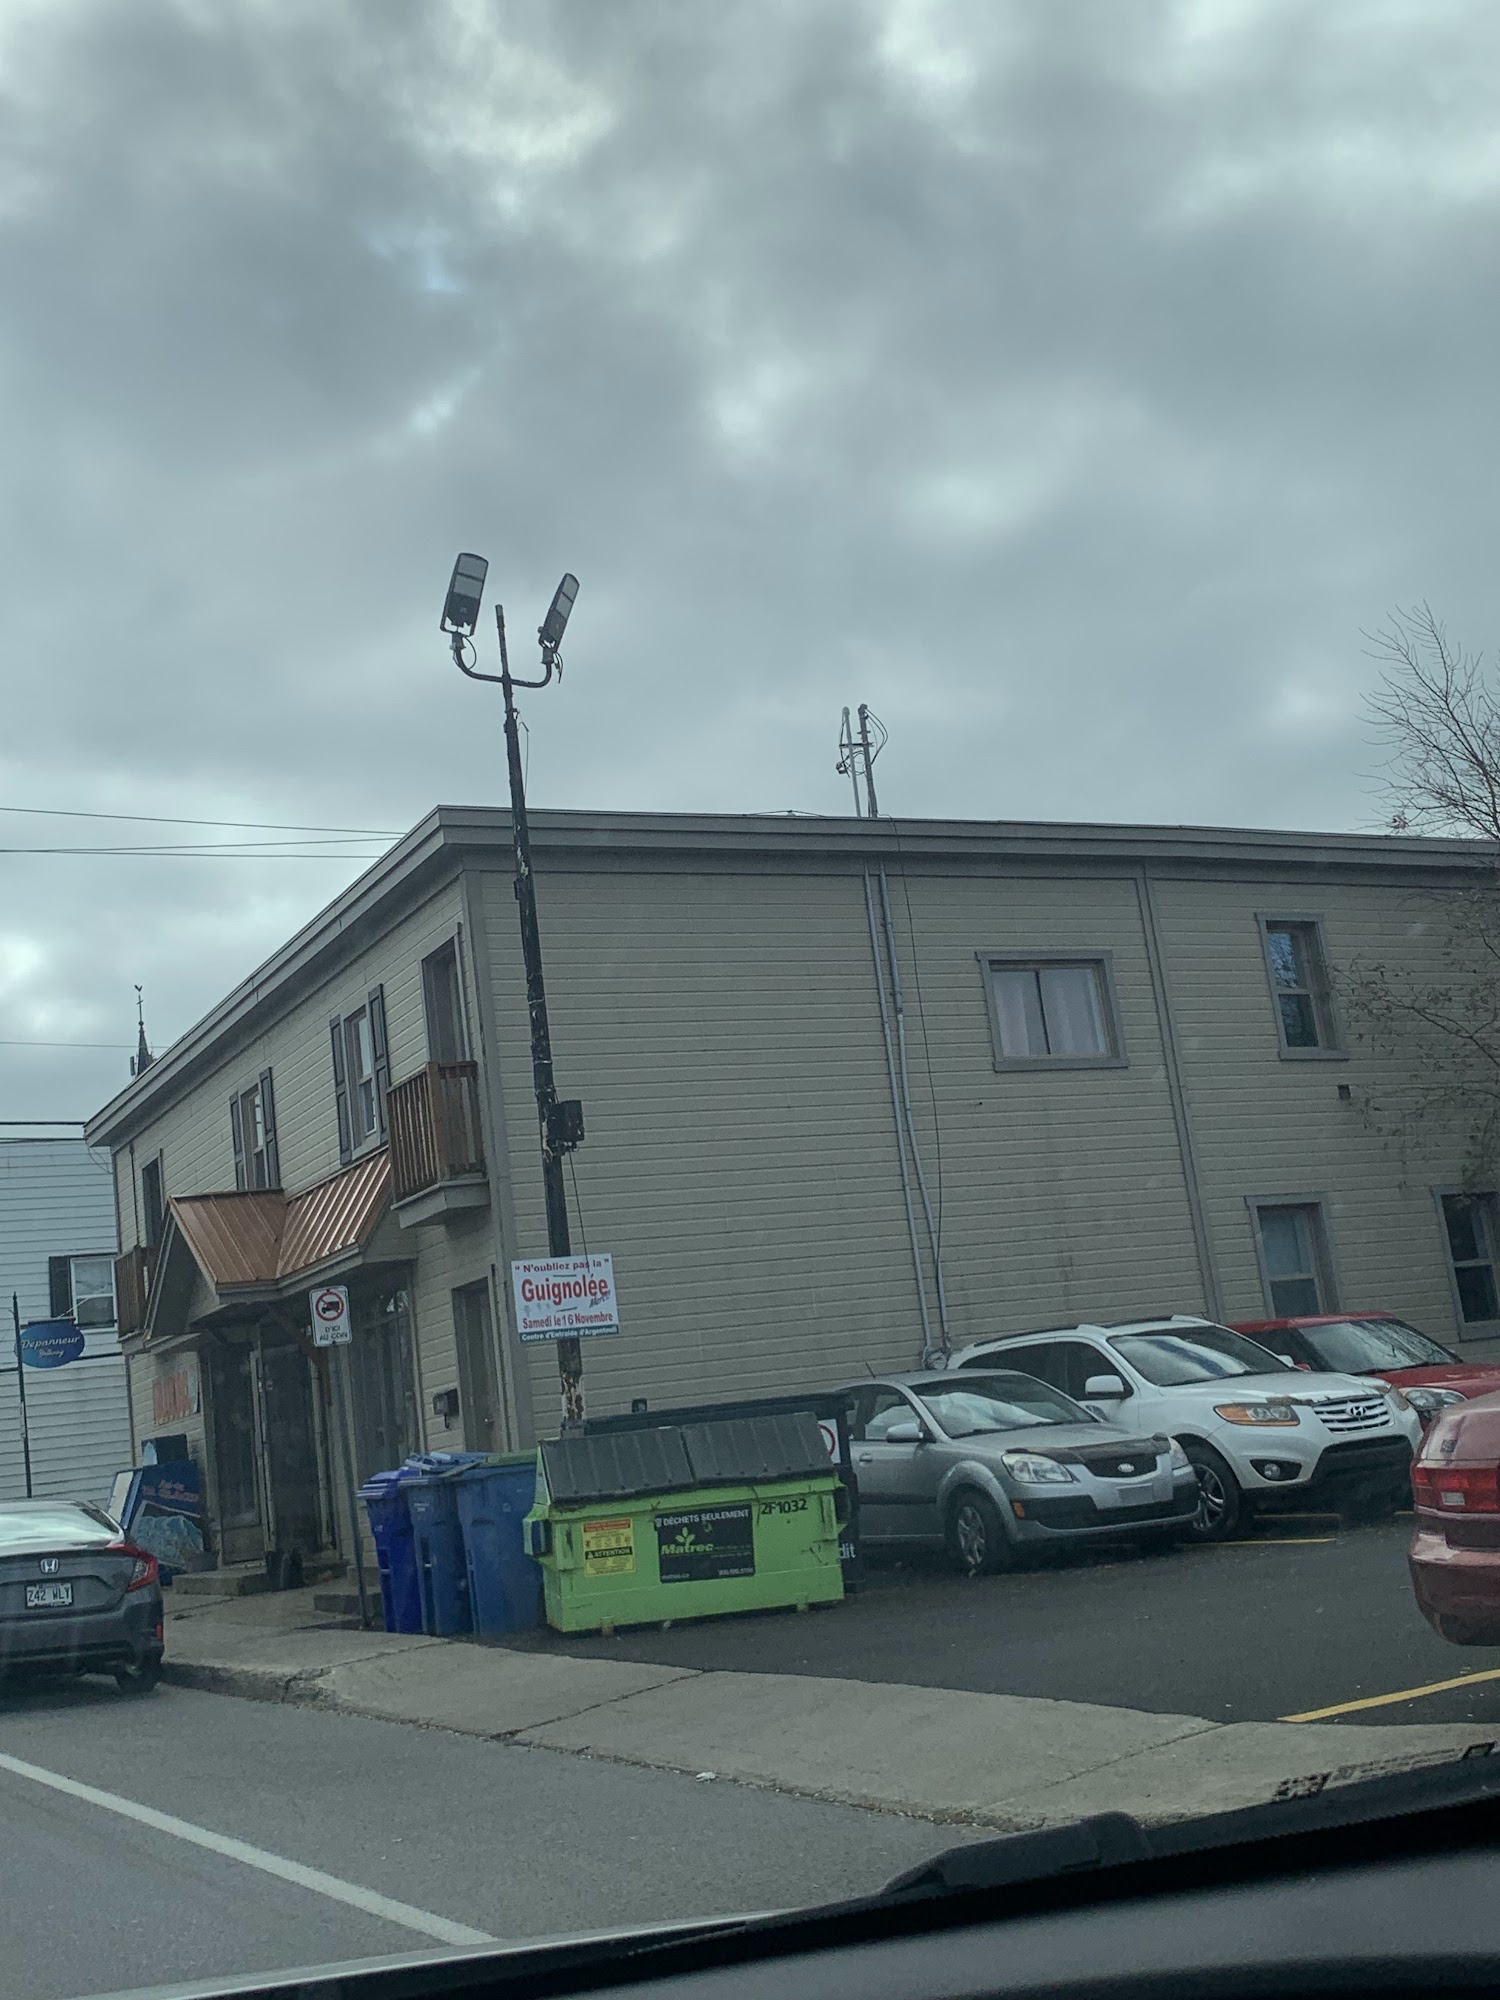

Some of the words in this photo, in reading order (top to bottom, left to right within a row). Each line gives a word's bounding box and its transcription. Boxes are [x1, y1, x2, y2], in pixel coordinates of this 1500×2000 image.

[573, 1260, 590, 1271] pas
[593, 1259, 602, 1268] la
[521, 1273, 609, 1306] Guignolée
[523, 1315, 552, 1329] Samedi
[554, 1314, 561, 1326] le
[562, 1314, 574, 1325] 16
[575, 1311, 613, 1323] Novembre
[761, 1498, 808, 1515] 2F1032
[701, 1509, 750, 1521] SEULEMENT
[661, 1543, 714, 1555] Matrec
[52, 1586, 70, 1600] WLY
